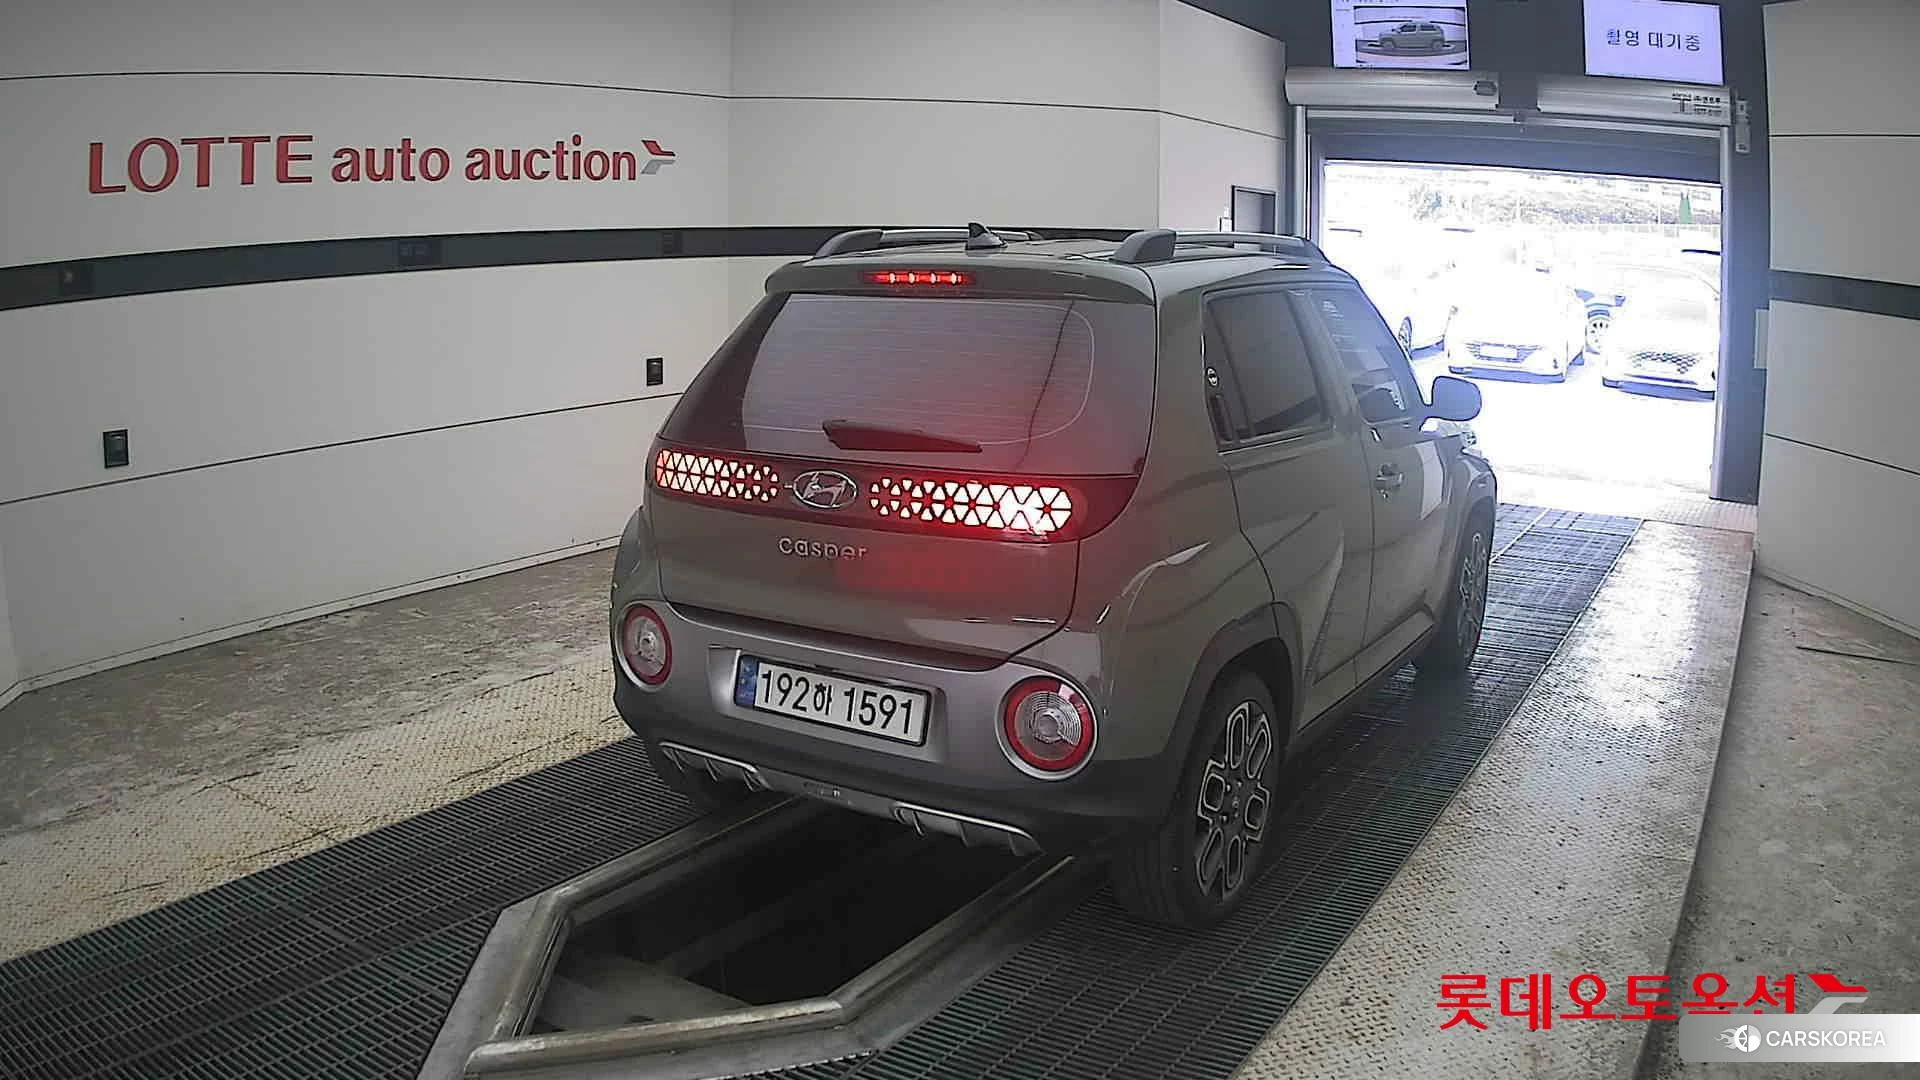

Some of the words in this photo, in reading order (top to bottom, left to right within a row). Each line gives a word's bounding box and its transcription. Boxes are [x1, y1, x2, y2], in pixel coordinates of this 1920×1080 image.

[1648, 31, 1701, 52] 대기중
[89, 135, 313, 194] LOTTE
[331, 138, 450, 183] auto
[465, 134, 638, 182] auction
[761, 669, 833, 716] 192하
[843, 686, 913, 735] 1591
